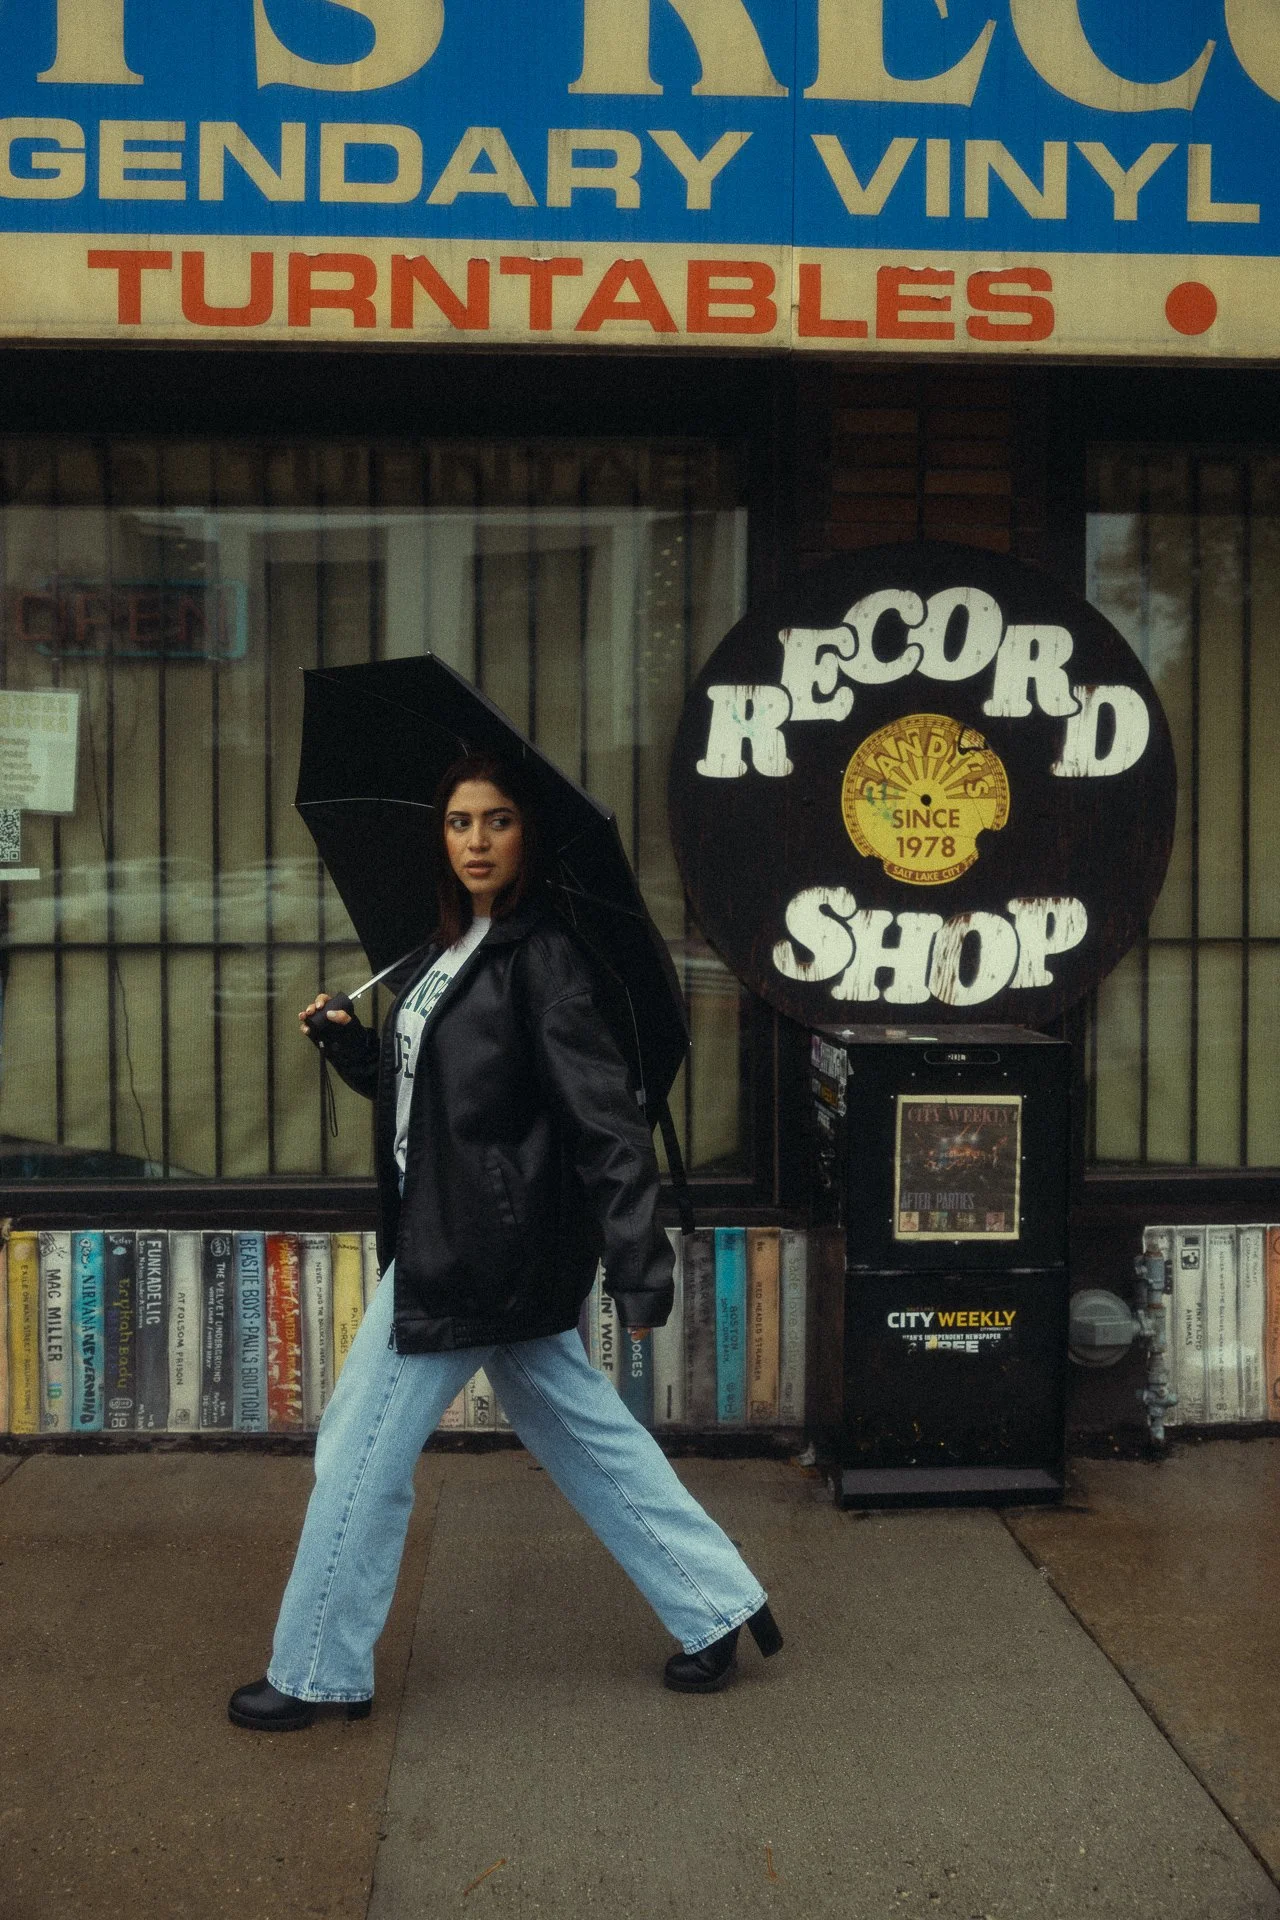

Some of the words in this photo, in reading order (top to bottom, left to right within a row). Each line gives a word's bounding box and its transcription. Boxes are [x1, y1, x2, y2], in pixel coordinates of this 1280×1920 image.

[0, 117, 754, 210] GENDARY
[811, 134, 1261, 224] VINYL
[88, 249, 1055, 342] TURNTABLES
[15, 591, 228, 642] OPEN
[696, 586, 1150, 778] RECORD
[892, 808, 960, 829] SINCE
[896, 836, 956, 859] 1978
[893, 864, 912, 878] SALT
[915, 872, 939, 882] LAKE
[943, 865, 962, 879] CITY
[772, 886, 1088, 1006] SHOP
[901, 1191, 932, 1210] AFTER
[936, 1191, 976, 1210] PARTIES
[216, 1262, 227, 1279] THE
[239, 1238, 260, 1286] BEASTIE
[46, 1269, 62, 1299] MAC
[146, 1240, 163, 1326] FUNKADELIC
[177, 1292, 186, 1304] AT
[215, 1281, 226, 1318] VELVET
[755, 1281, 763, 1299] RED
[81, 1275, 97, 1332] NIRVANA
[241, 1289, 261, 1320] BOYS
[351, 1307, 359, 1329] PATTI
[755, 1302, 763, 1334] HEADED
[887, 1311, 935, 1328] CITY
[938, 1311, 1016, 1327] WEEKLY
[48, 1307, 63, 1362] MILLER
[177, 1307, 186, 1348] FOLSOM
[242, 1326, 261, 1364] PAUL'S
[340, 1323, 349, 1354] HORSES
[729, 1306, 740, 1351] BOSTON
[925, 1333, 964, 1341] INPENDENT
[965, 1333, 1001, 1341] NEWSPAPER
[213, 1320, 224, 1383] UNDERGROUND
[601, 1323, 614, 1371] WOLF
[79, 1334, 97, 1425] NEVERMIND
[176, 1352, 185, 1386] PRISON
[241, 1367, 261, 1423] BOUTIQUE
